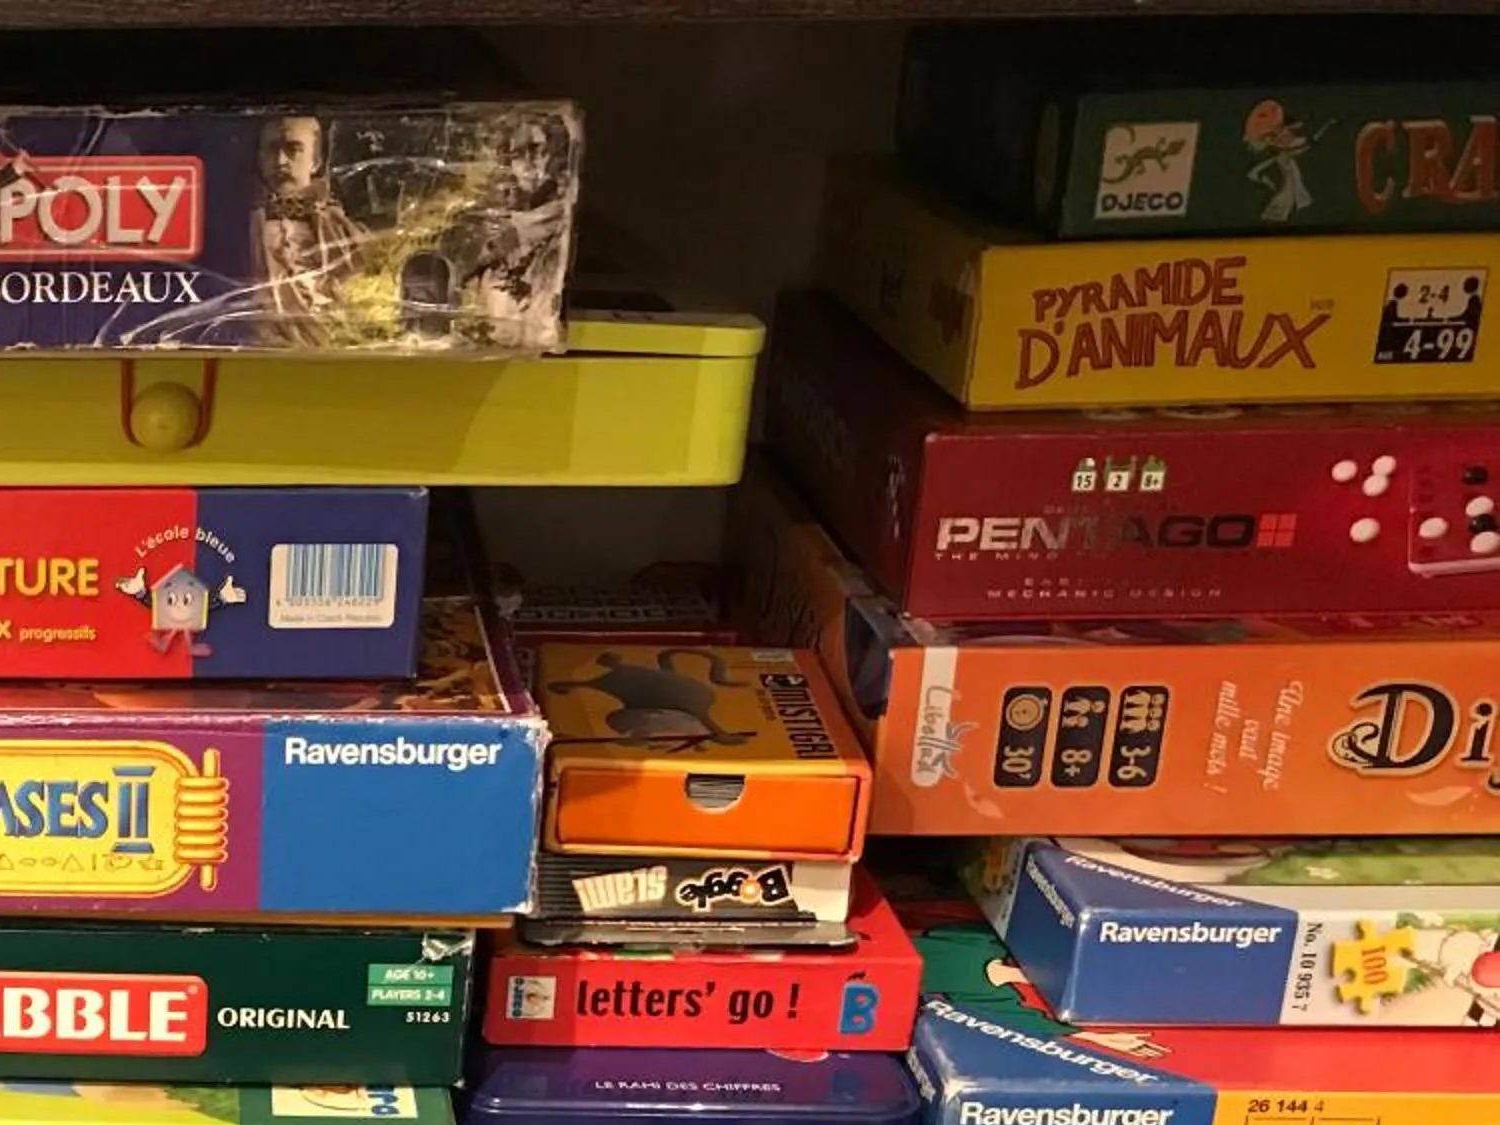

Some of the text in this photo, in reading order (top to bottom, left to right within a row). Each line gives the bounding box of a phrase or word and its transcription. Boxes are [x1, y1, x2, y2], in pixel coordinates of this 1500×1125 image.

[1101, 192, 1183, 213] DJECO
[1032, 256, 1246, 324] PYRAMIDE
[1417, 284, 1450, 304] 2-4
[1014, 309, 1331, 390] D'ANIMAUX
[1403, 328, 1474, 360] 4-99
[1075, 472, 1094, 489] 15
[133, 524, 237, 564] L'école bleue
[937, 513, 1256, 551] PENTAGO
[19, 624, 97, 643] progressifs
[1212, 680, 1238, 733] mille
[284, 736, 502, 771] Ravensburger
[1264, 681, 1305, 791] Une image
[1328, 680, 1500, 795] Di
[1060, 746, 1092, 778] 8+
[1116, 745, 1149, 781] 3-6
[677, 866, 793, 912] Boggle
[1065, 856, 1242, 909] Ravensburger
[1100, 922, 1281, 947] Ravensburger
[384, 968, 411, 982] AGE
[1359, 943, 1389, 986] 100
[372, 988, 421, 1001] PLAYERS
[577, 980, 800, 1022] letters' go !
[838, 983, 879, 1034] B
[218, 1007, 350, 1030] ORIGINAL
[406, 1011, 450, 1024] 51263
[925, 1000, 1158, 1087] Ravensburger
[595, 1081, 613, 1089] LE
[666, 1082, 698, 1091] DES
[703, 1082, 781, 1091] CHIFFRES
[1247, 1099, 1308, 1113] 26 144
